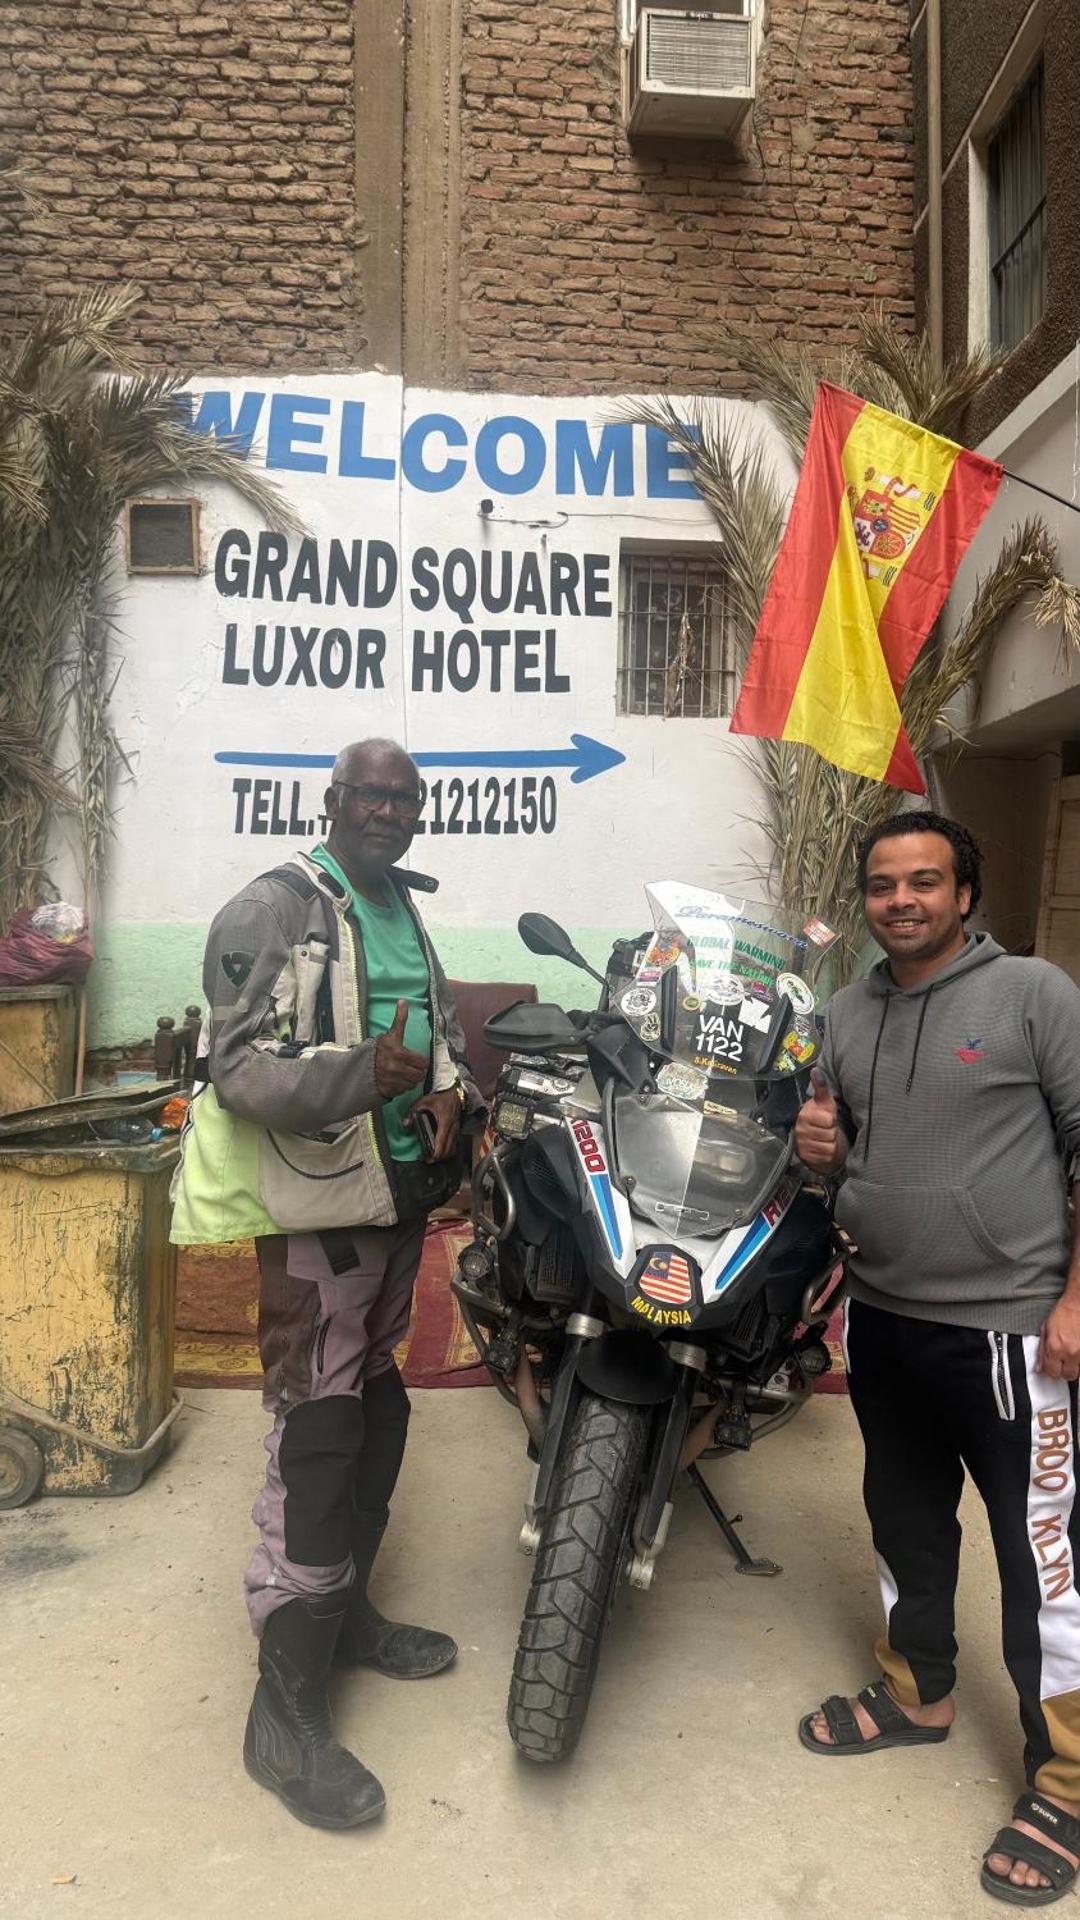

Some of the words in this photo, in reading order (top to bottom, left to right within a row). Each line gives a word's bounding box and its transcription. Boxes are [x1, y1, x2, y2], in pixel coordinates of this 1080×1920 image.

[172, 391, 705, 500] WELCOME
[214, 528, 398, 609] GRAND
[410, 546, 612, 624] SQUARE
[222, 623, 386, 689] LUXOR
[411, 629, 571, 693] HOTEL
[696, 1034, 743, 1063] 1122
[699, 1014, 744, 1042] VAN
[631, 1295, 692, 1325] MALAYSIA
